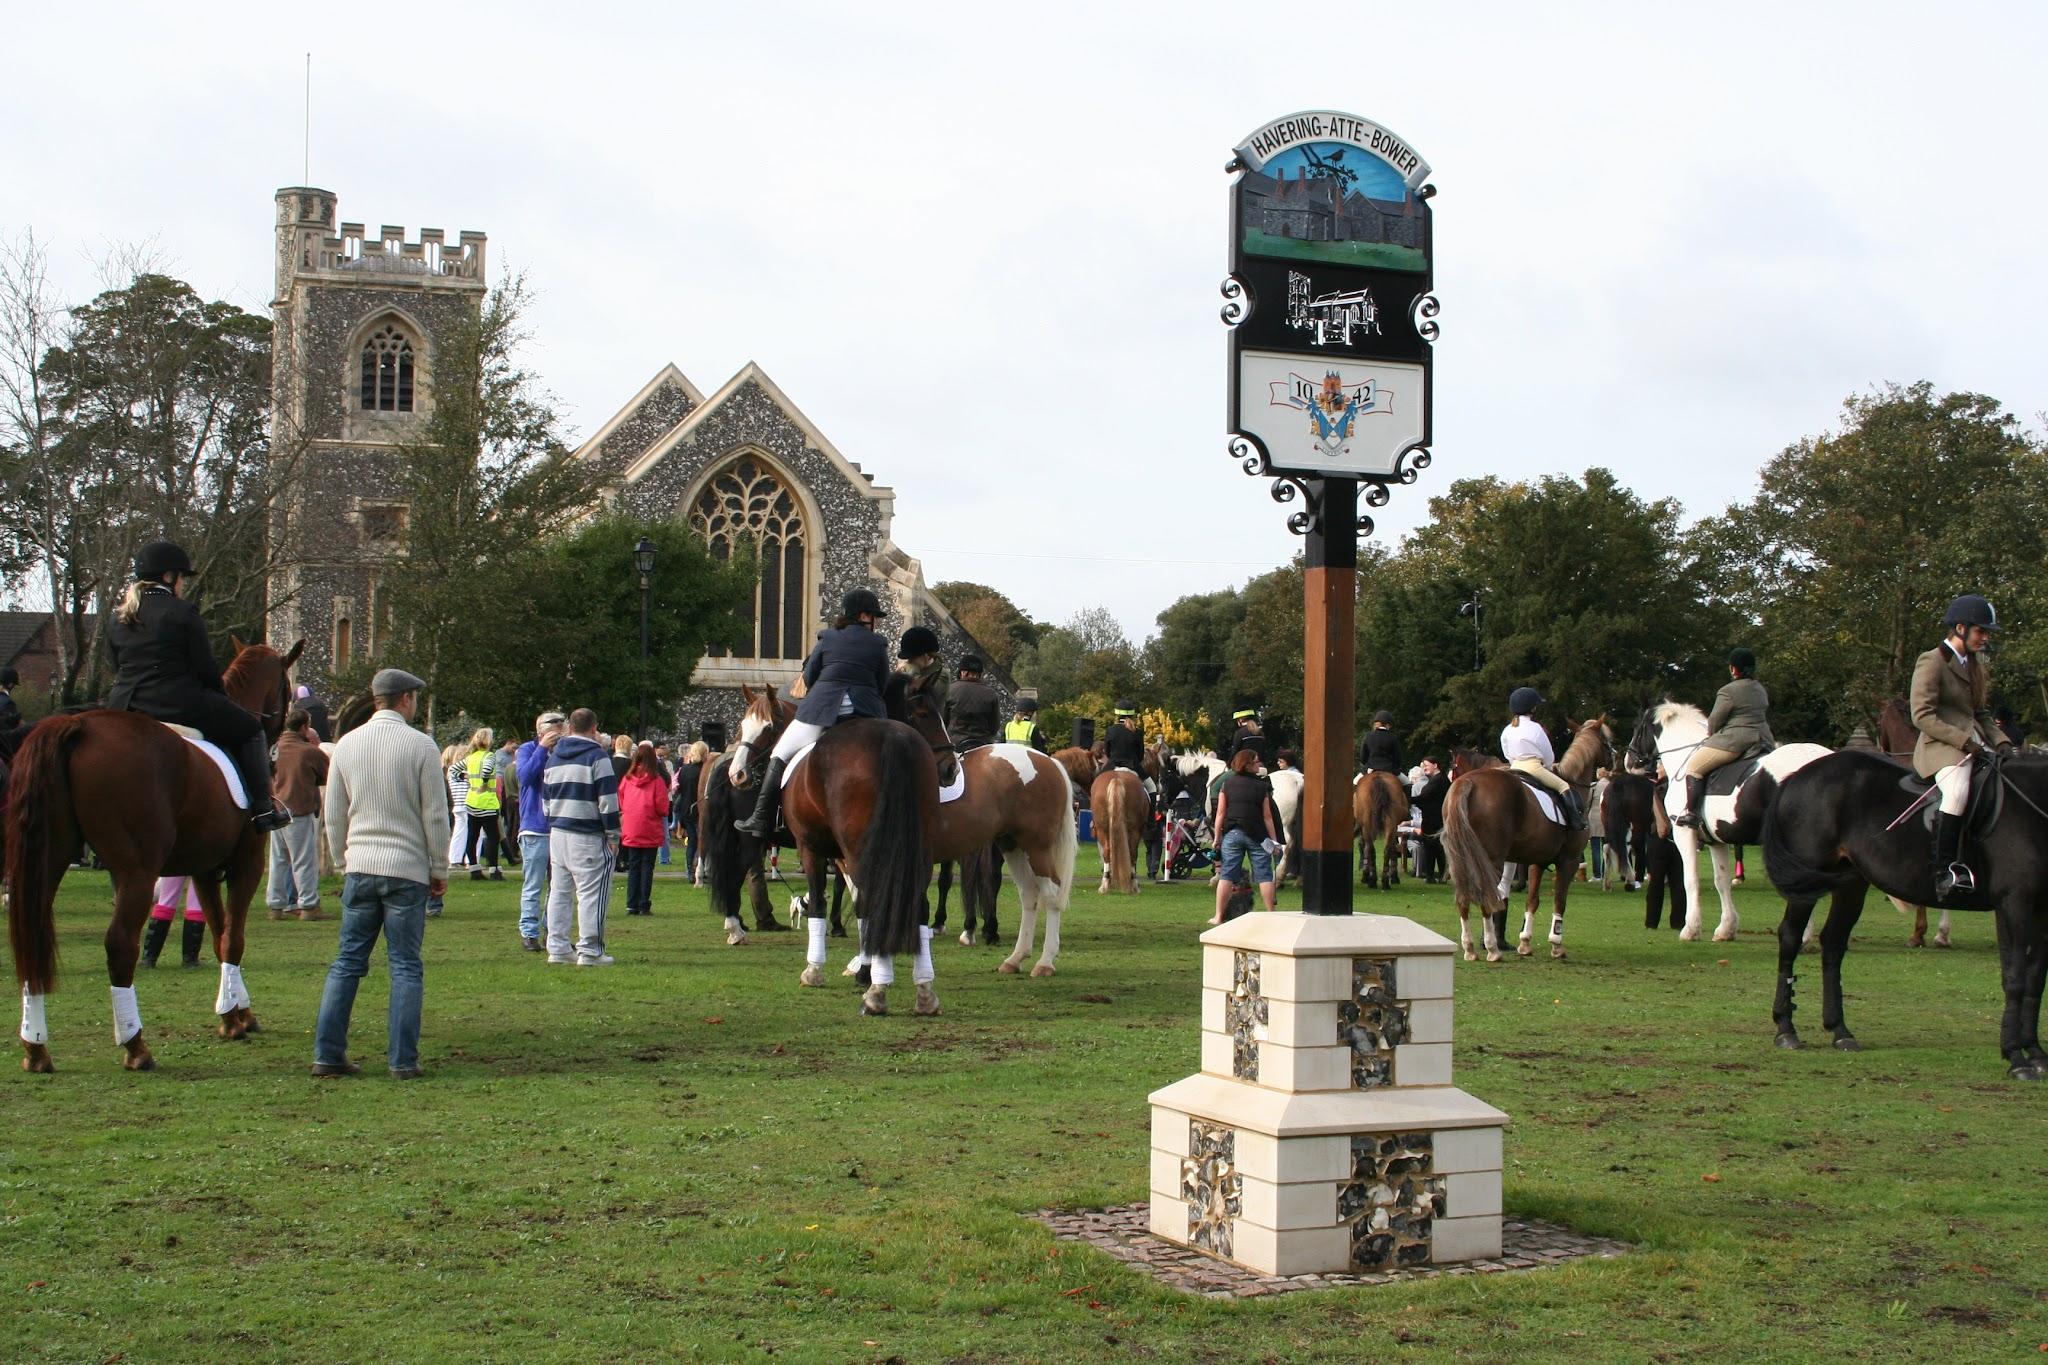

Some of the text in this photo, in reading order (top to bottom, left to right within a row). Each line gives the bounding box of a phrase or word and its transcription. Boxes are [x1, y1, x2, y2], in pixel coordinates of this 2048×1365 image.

[1251, 116, 1418, 175] HAVERING-ATTE-BOWER
[1296, 381, 1371, 404] 10 42
